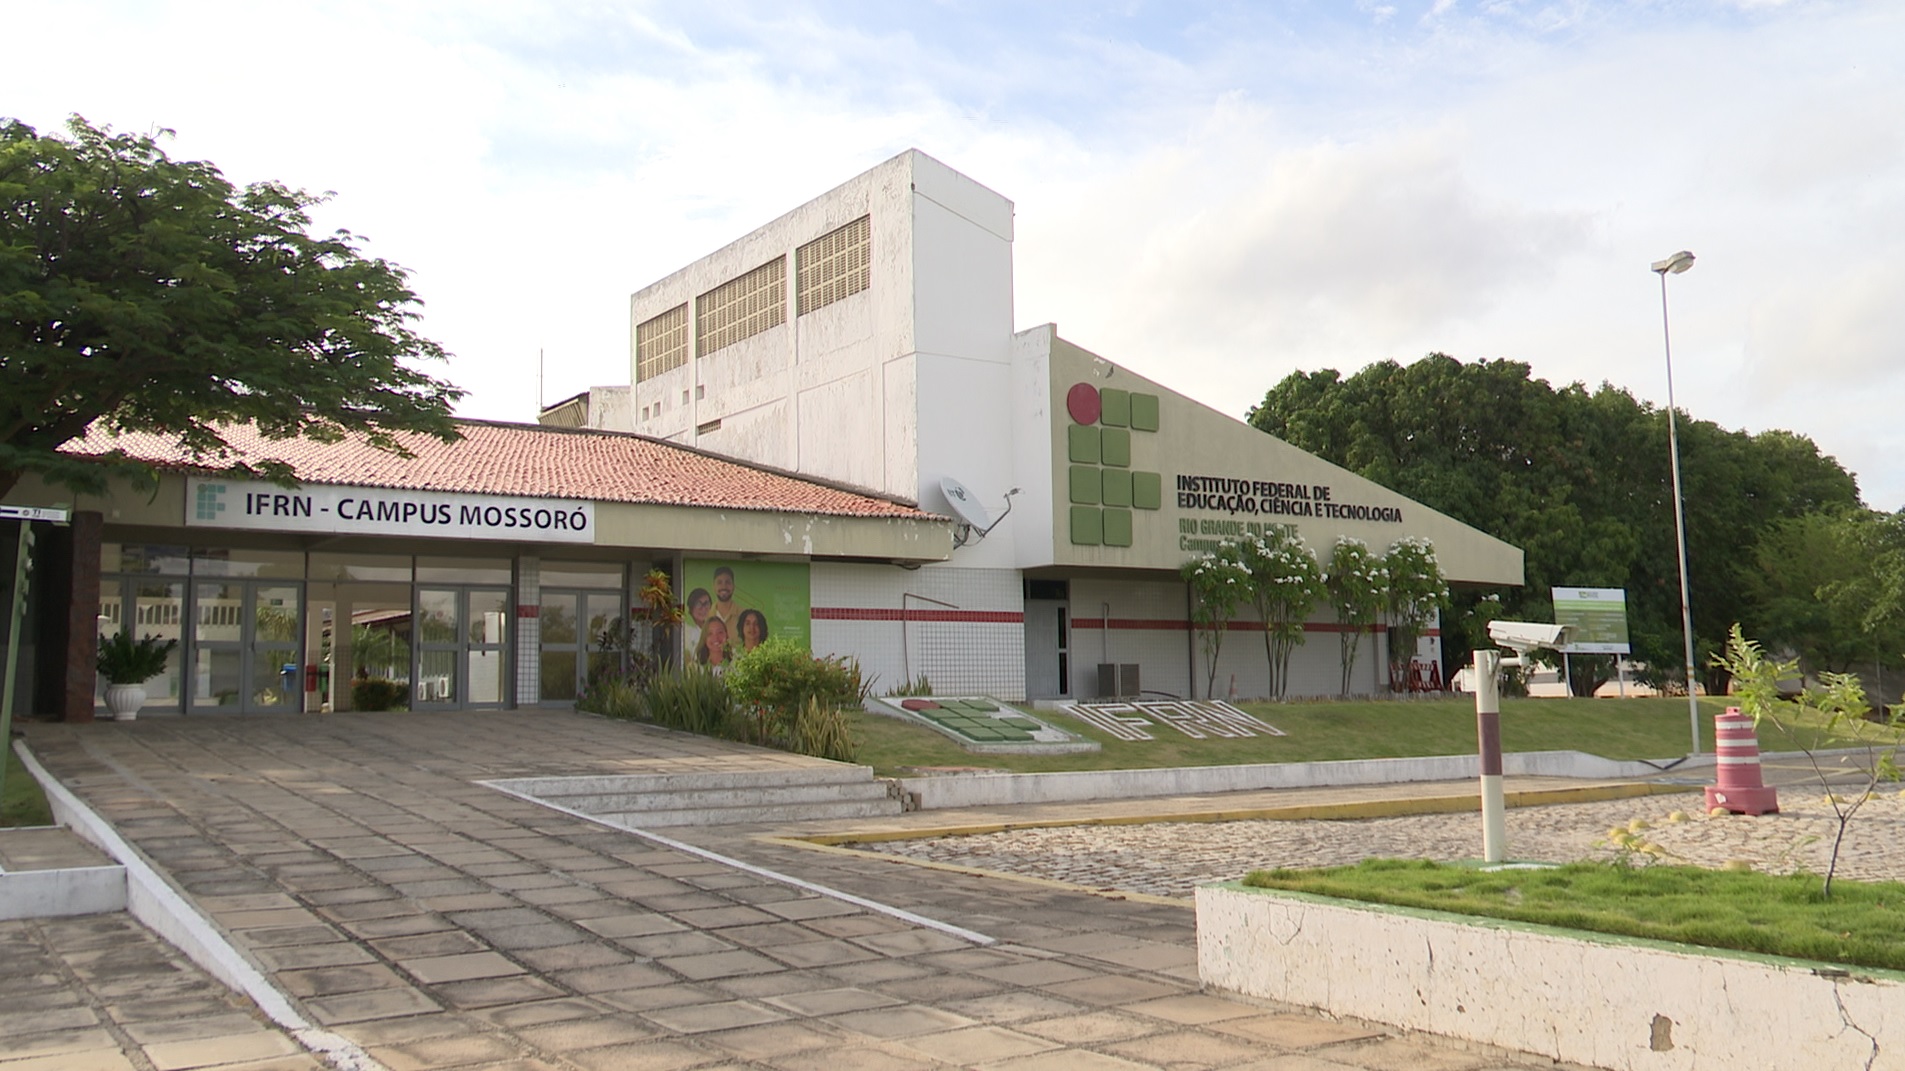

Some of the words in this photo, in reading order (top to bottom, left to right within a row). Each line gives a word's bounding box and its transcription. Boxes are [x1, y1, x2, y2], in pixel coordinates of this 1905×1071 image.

[1177, 475, 1250, 495] INSTITUTO
[1253, 481, 1311, 500] FEDERAL
[1313, 486, 1331, 501] DE
[246, 493, 312, 517] IFRN
[337, 498, 451, 525] CAMPUS
[459, 505, 587, 531] MOSSORÓ
[1178, 492, 1259, 516] EDUCAÇÃO,
[1261, 496, 1313, 517] CIÊNCIA
[1315, 503, 1323, 517] E
[1324, 503, 1403, 523] TECNOLOGIA
[1179, 518, 1198, 535] RIO
[1200, 519, 1245, 537] GRANDE
[1246, 521, 1261, 538] DO
[1058, 700, 1287, 741] IFRN
